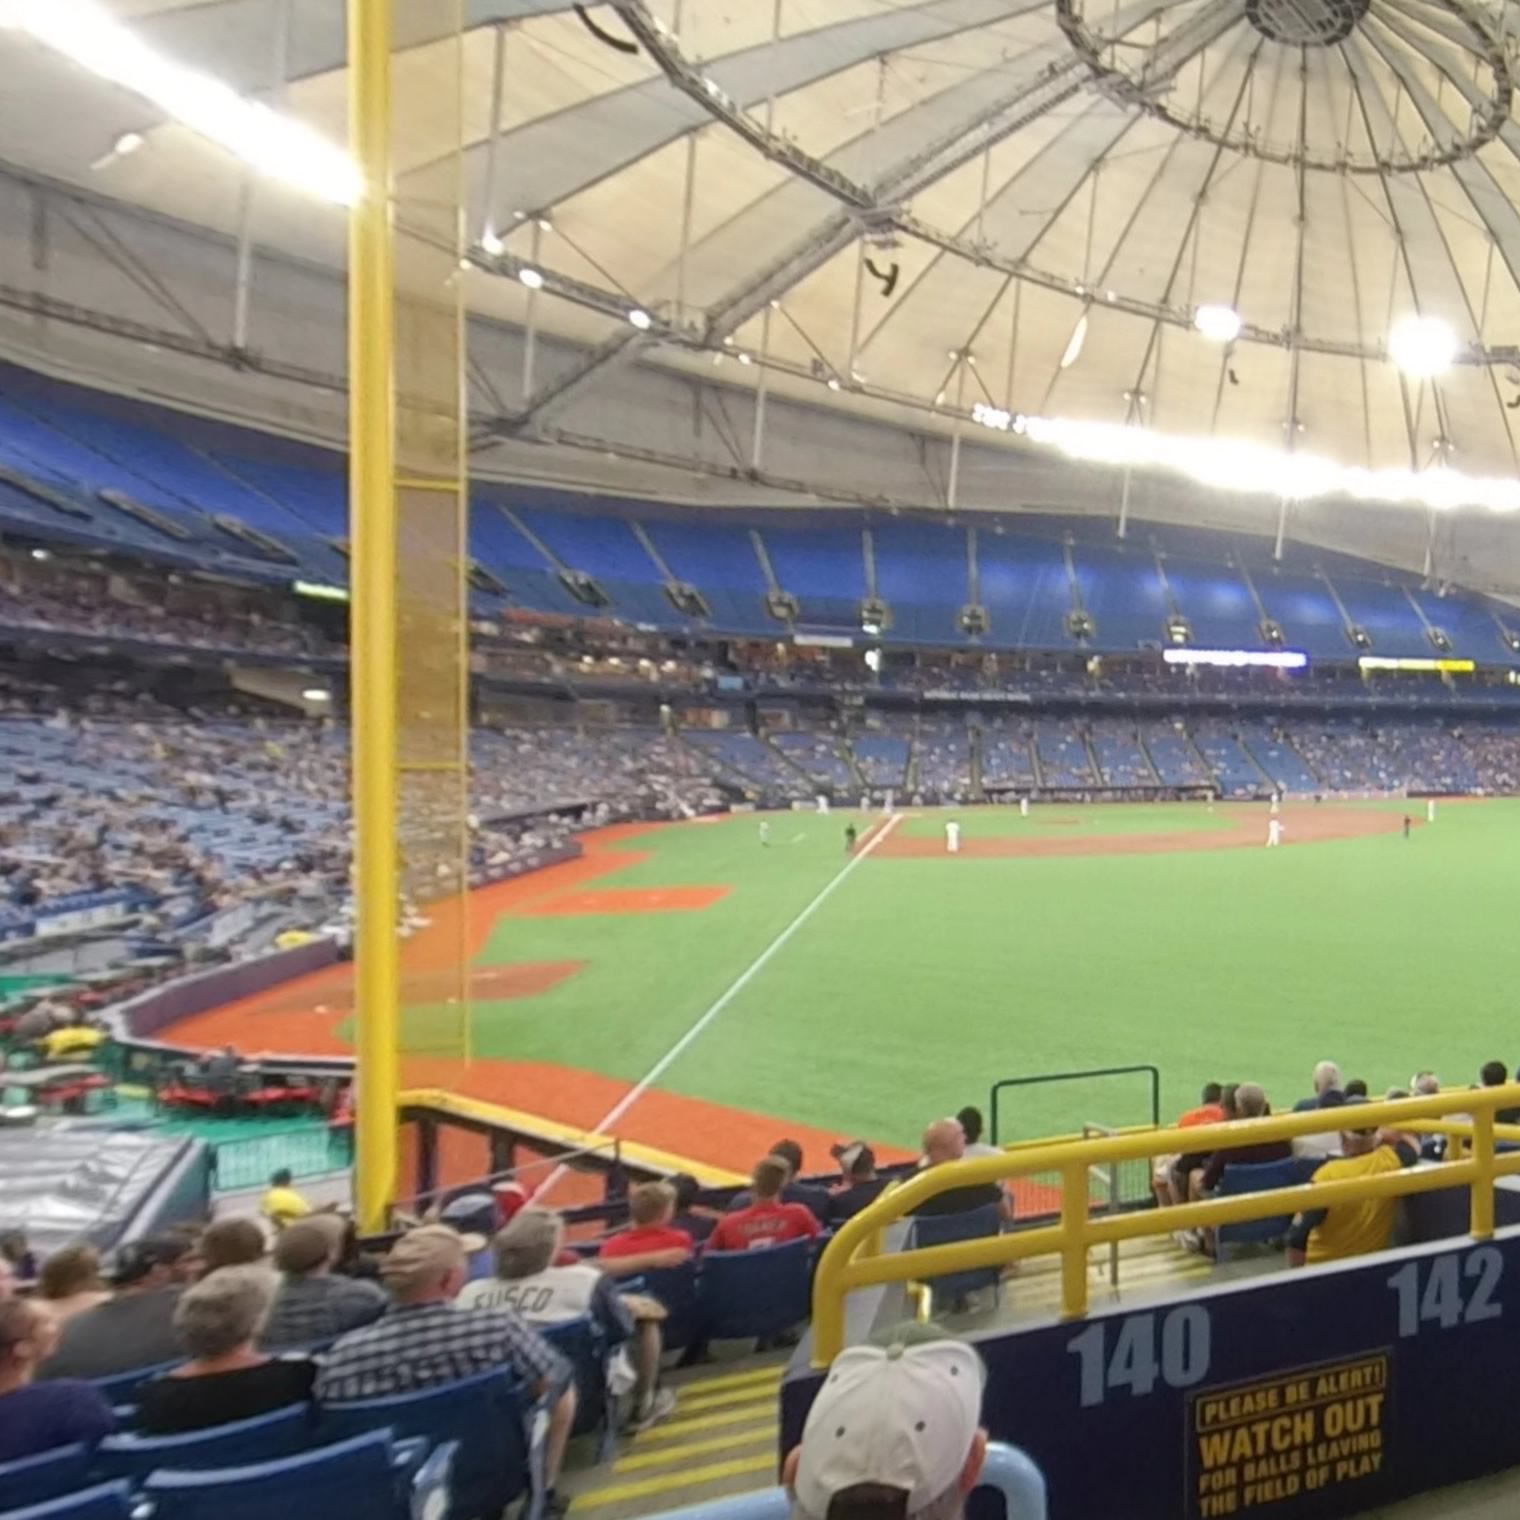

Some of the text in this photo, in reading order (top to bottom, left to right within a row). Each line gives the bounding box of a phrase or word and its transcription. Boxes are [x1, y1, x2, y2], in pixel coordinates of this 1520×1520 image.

[1387, 1246, 1504, 1338] 142
[1067, 1305, 1212, 1407] 140
[1205, 1364, 1381, 1425] PLEASE BE ALERT!
[1200, 1394, 1384, 1470] WATCH OUT
[1200, 1429, 1382, 1494] FOR BALLS LEAVING
[1199, 1452, 1383, 1519] THE FIELD OF PLAY
